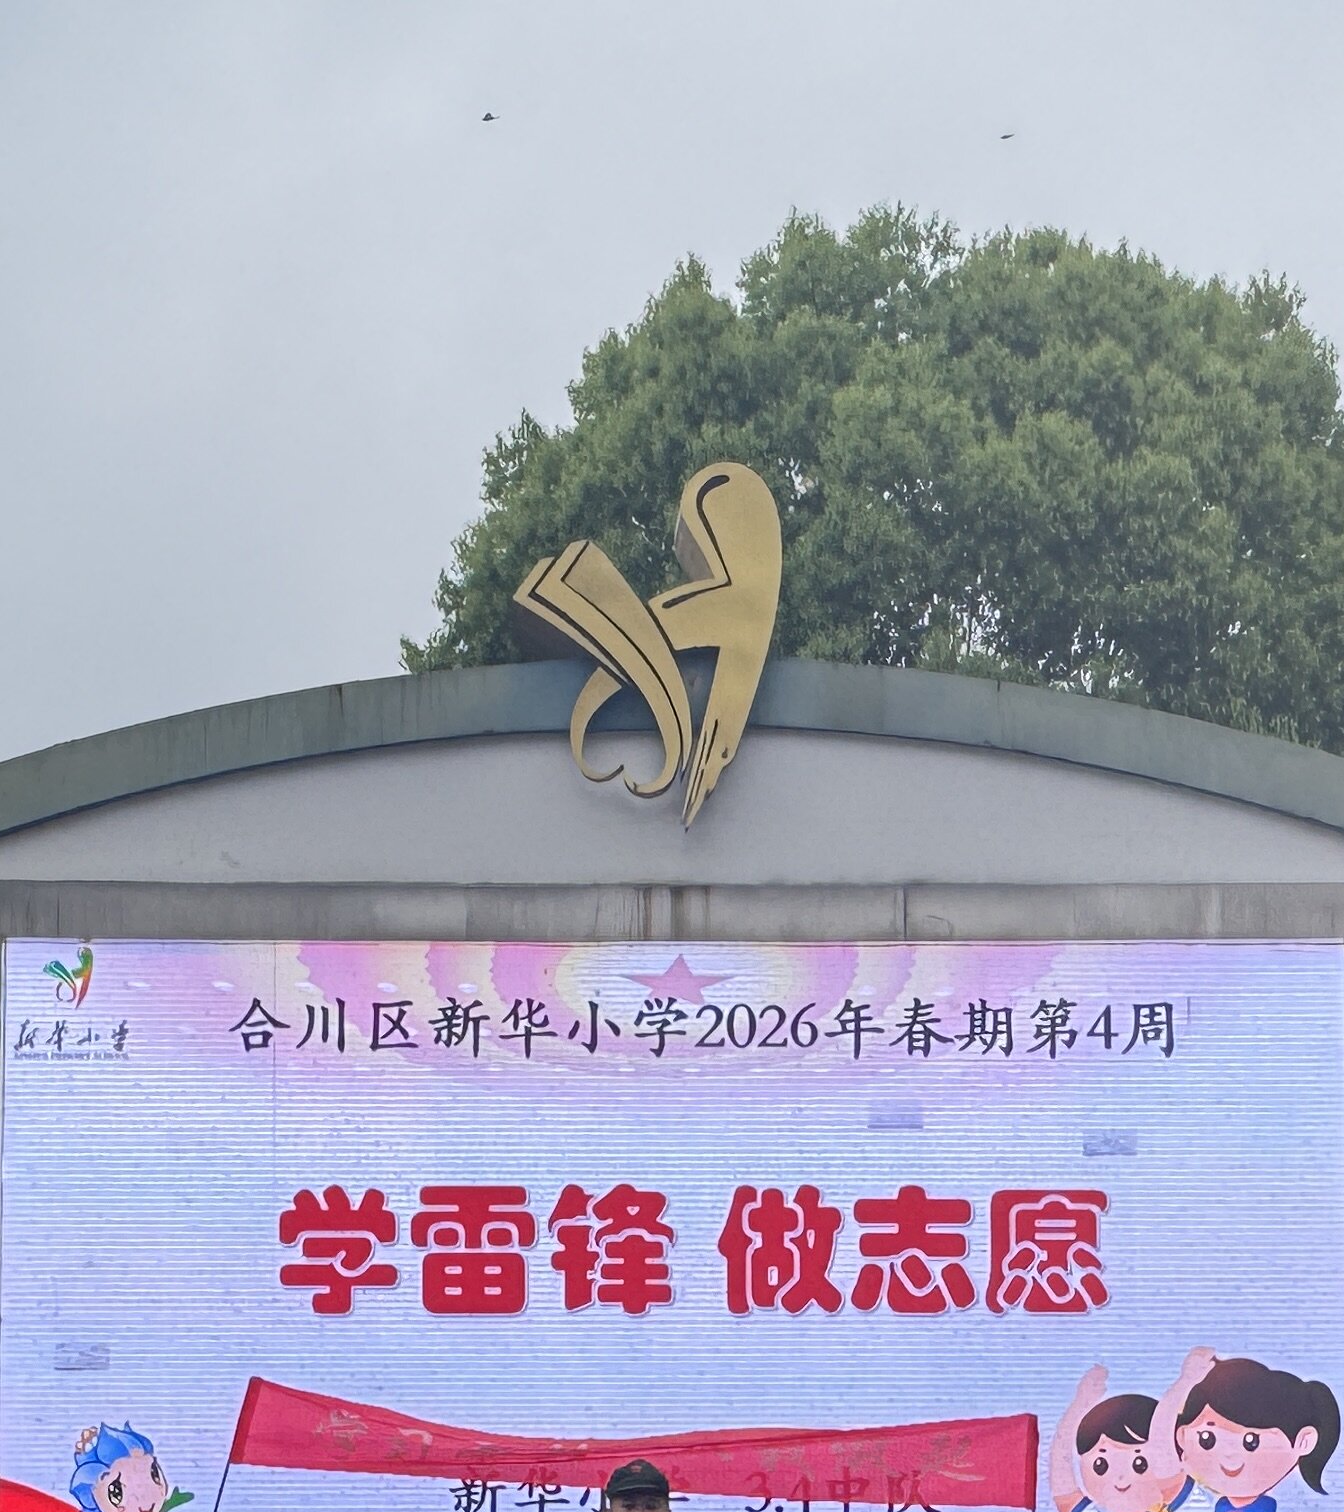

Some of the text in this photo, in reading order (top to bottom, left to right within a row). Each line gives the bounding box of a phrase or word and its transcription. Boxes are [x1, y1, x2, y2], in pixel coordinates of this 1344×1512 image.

[229, 996, 1175, 1060] 合川区新华小学2026年春期第4周
[279, 1183, 1113, 1315] 学雷锋 做志愿
